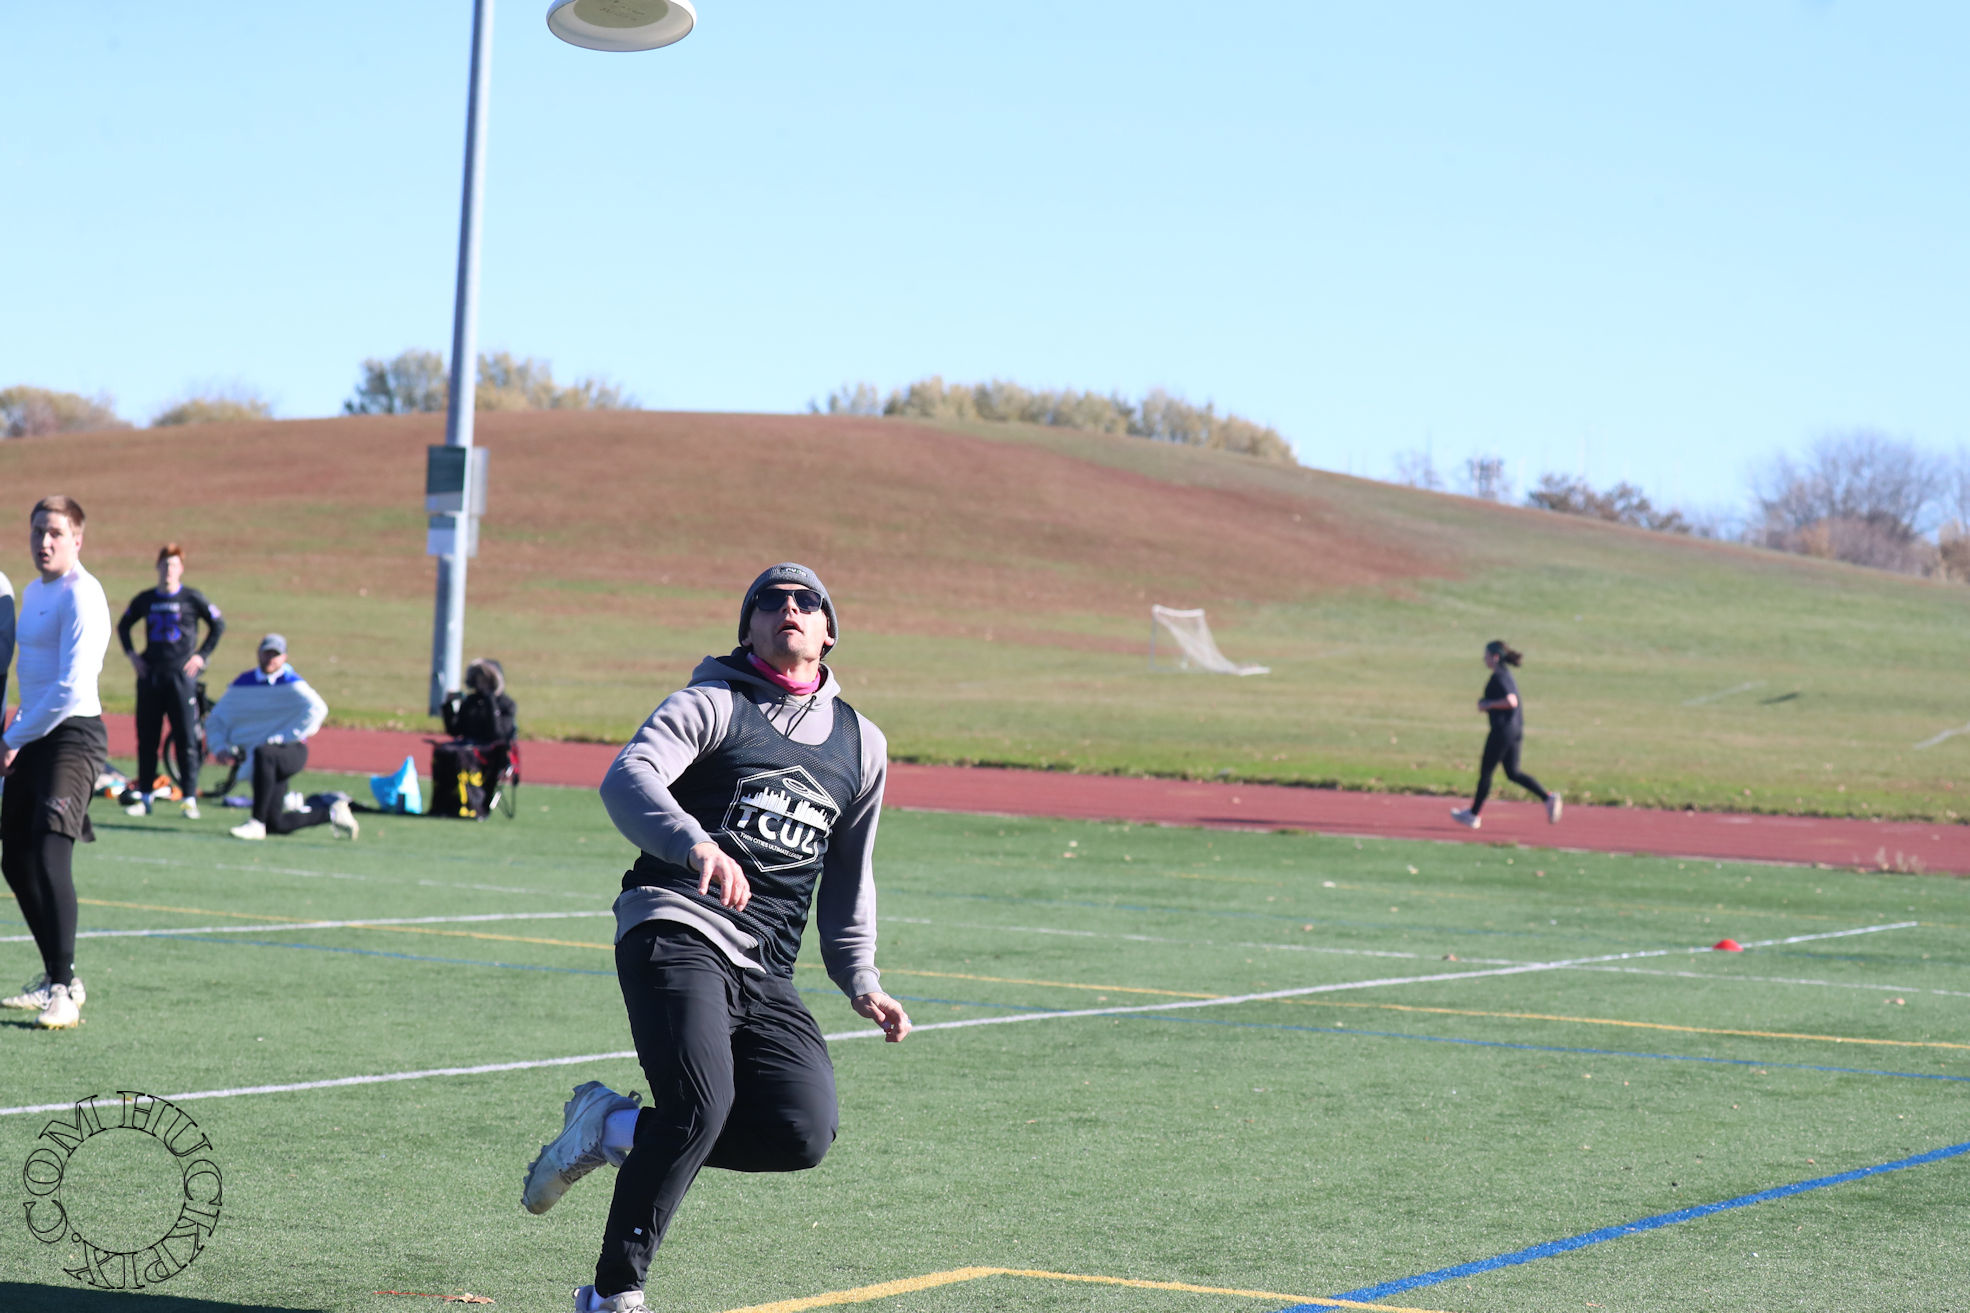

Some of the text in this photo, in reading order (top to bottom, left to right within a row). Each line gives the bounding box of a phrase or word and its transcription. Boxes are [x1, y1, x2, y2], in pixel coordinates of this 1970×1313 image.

[148, 613, 182, 642] 25
[737, 805, 816, 854] TCUL
[740, 832, 753, 841] TWIN
[753, 838, 768, 847] CITIES
[768, 843, 790, 856] ULTIMATE
